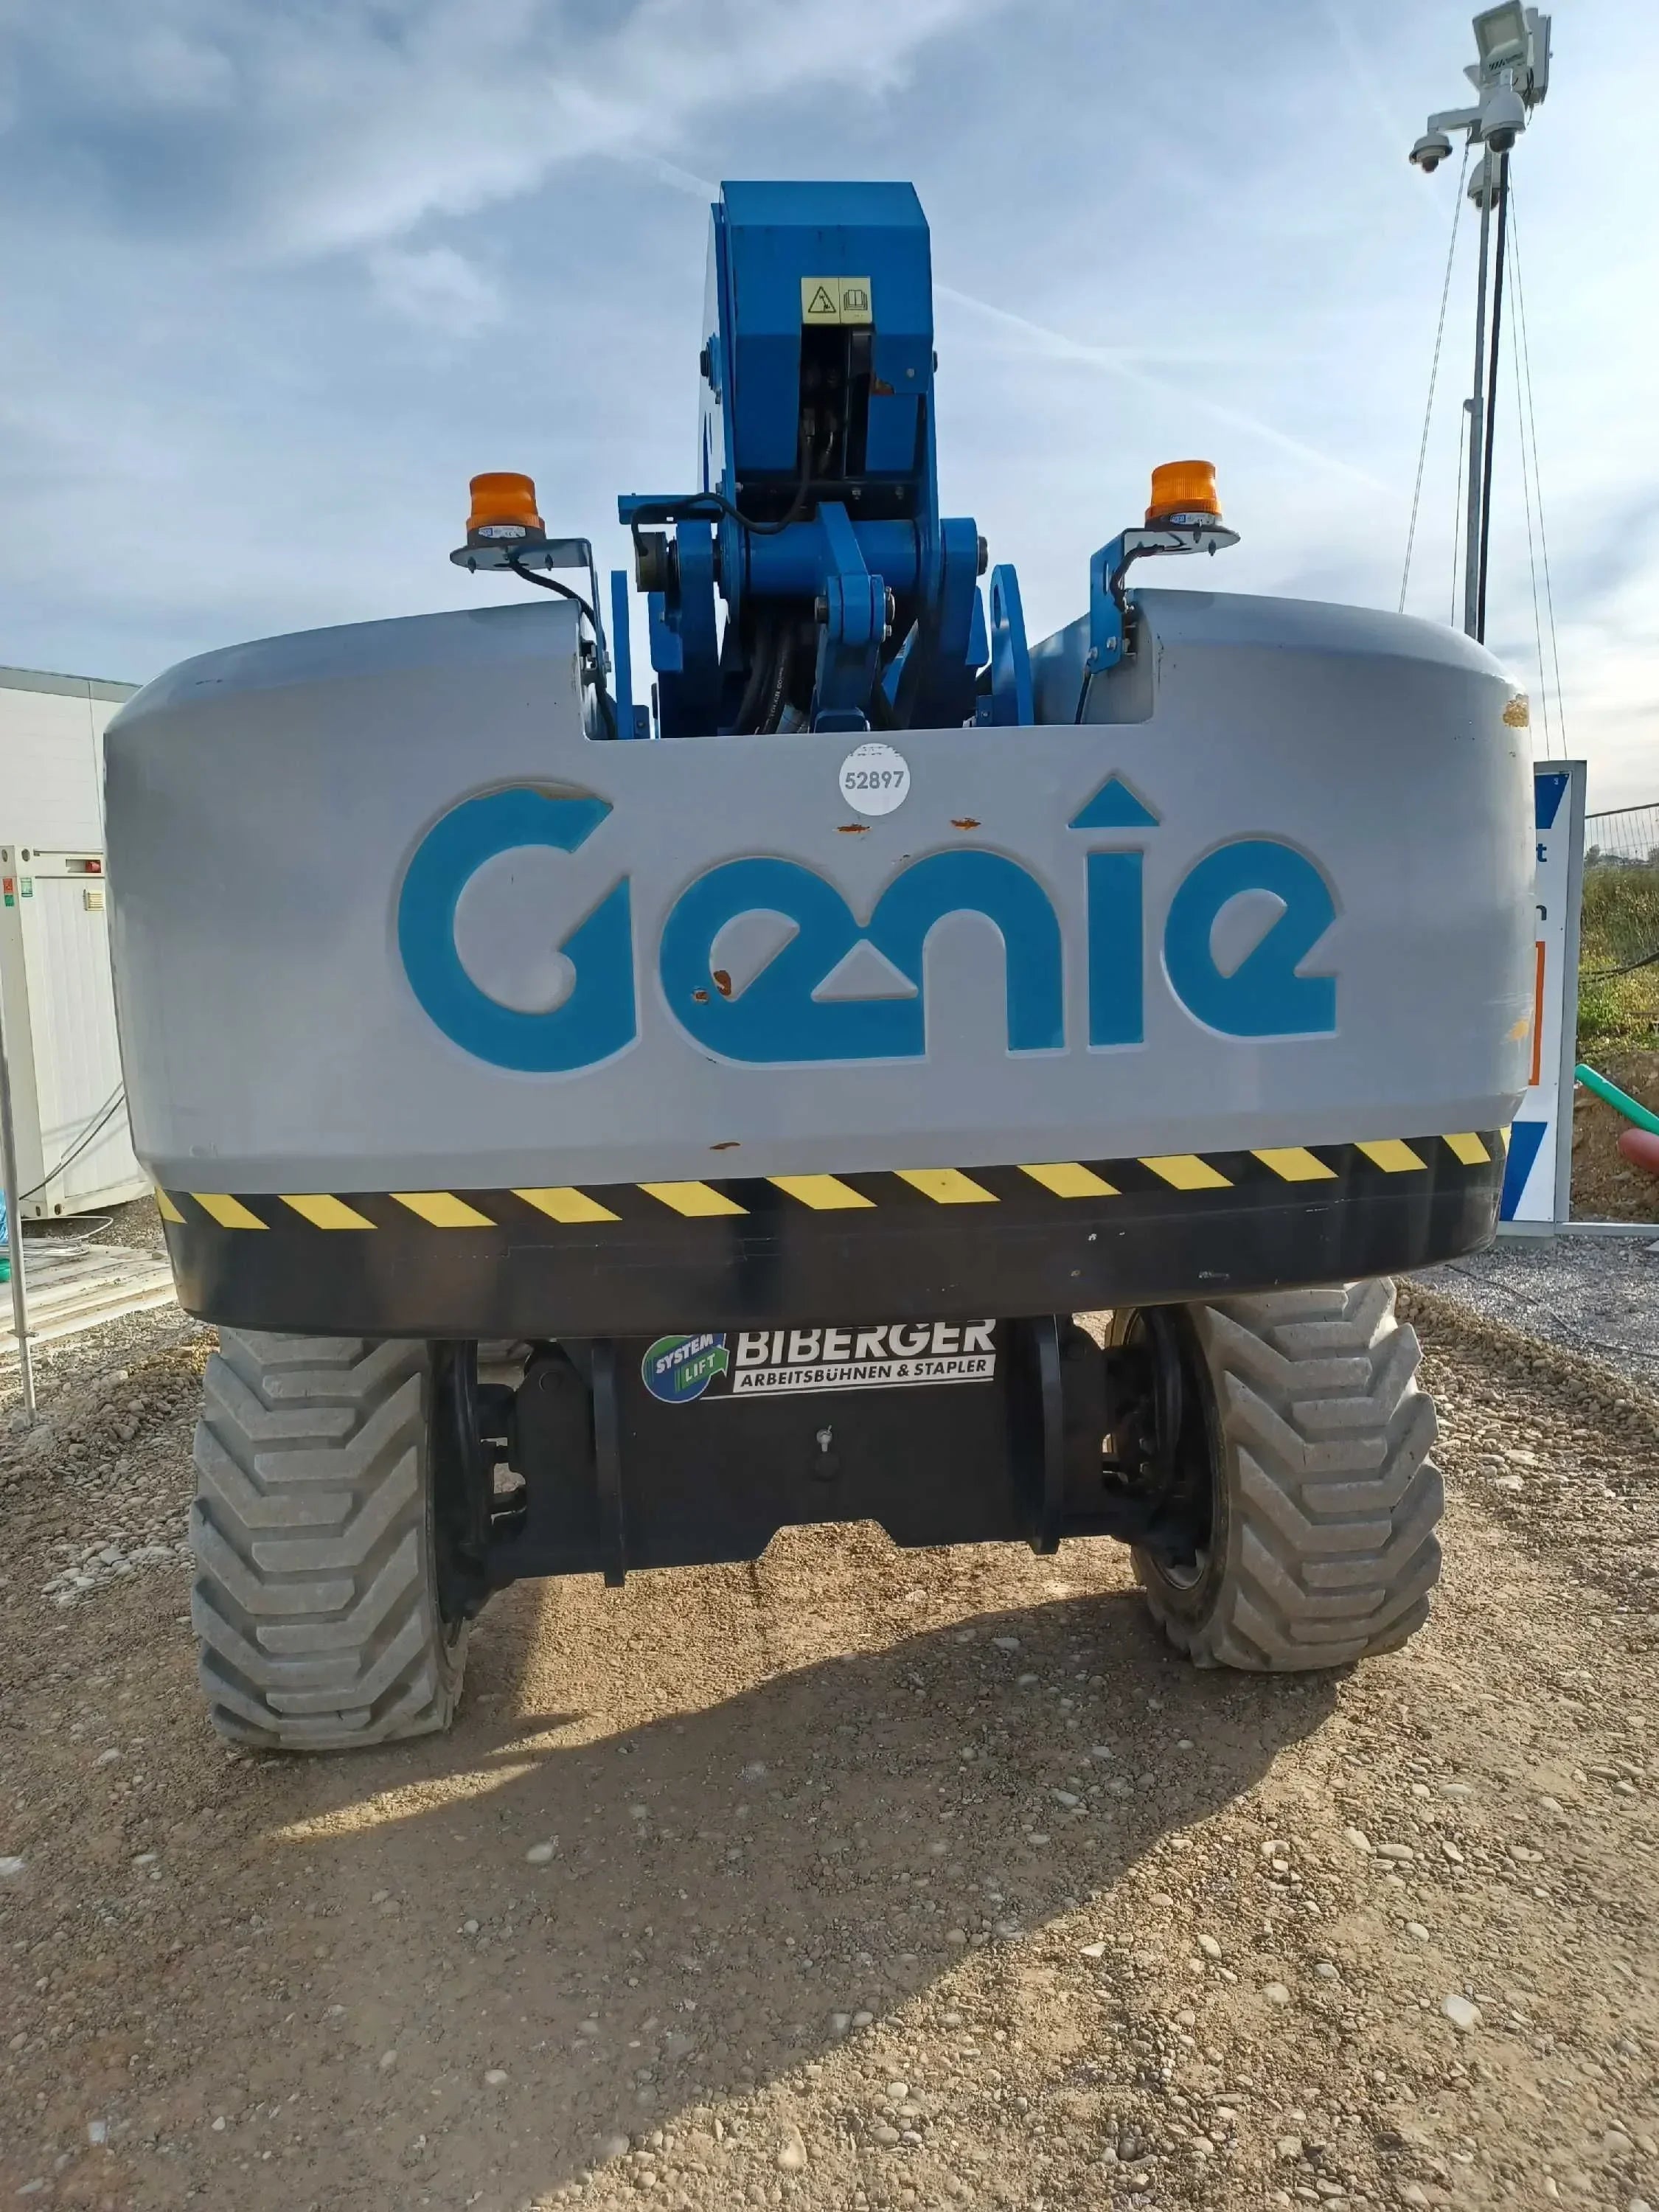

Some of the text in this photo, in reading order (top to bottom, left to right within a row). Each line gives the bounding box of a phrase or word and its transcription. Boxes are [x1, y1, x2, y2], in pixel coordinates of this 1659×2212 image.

[845, 771, 904, 790] 52897
[397, 775, 1337, 1074] Genie
[655, 1333, 714, 1374] SYSTEM
[736, 1318, 996, 1366] BIBERGER
[685, 1353, 716, 1382] LIFT
[740, 1359, 987, 1388] ARBEITSBÜHNEN & STAPLER
